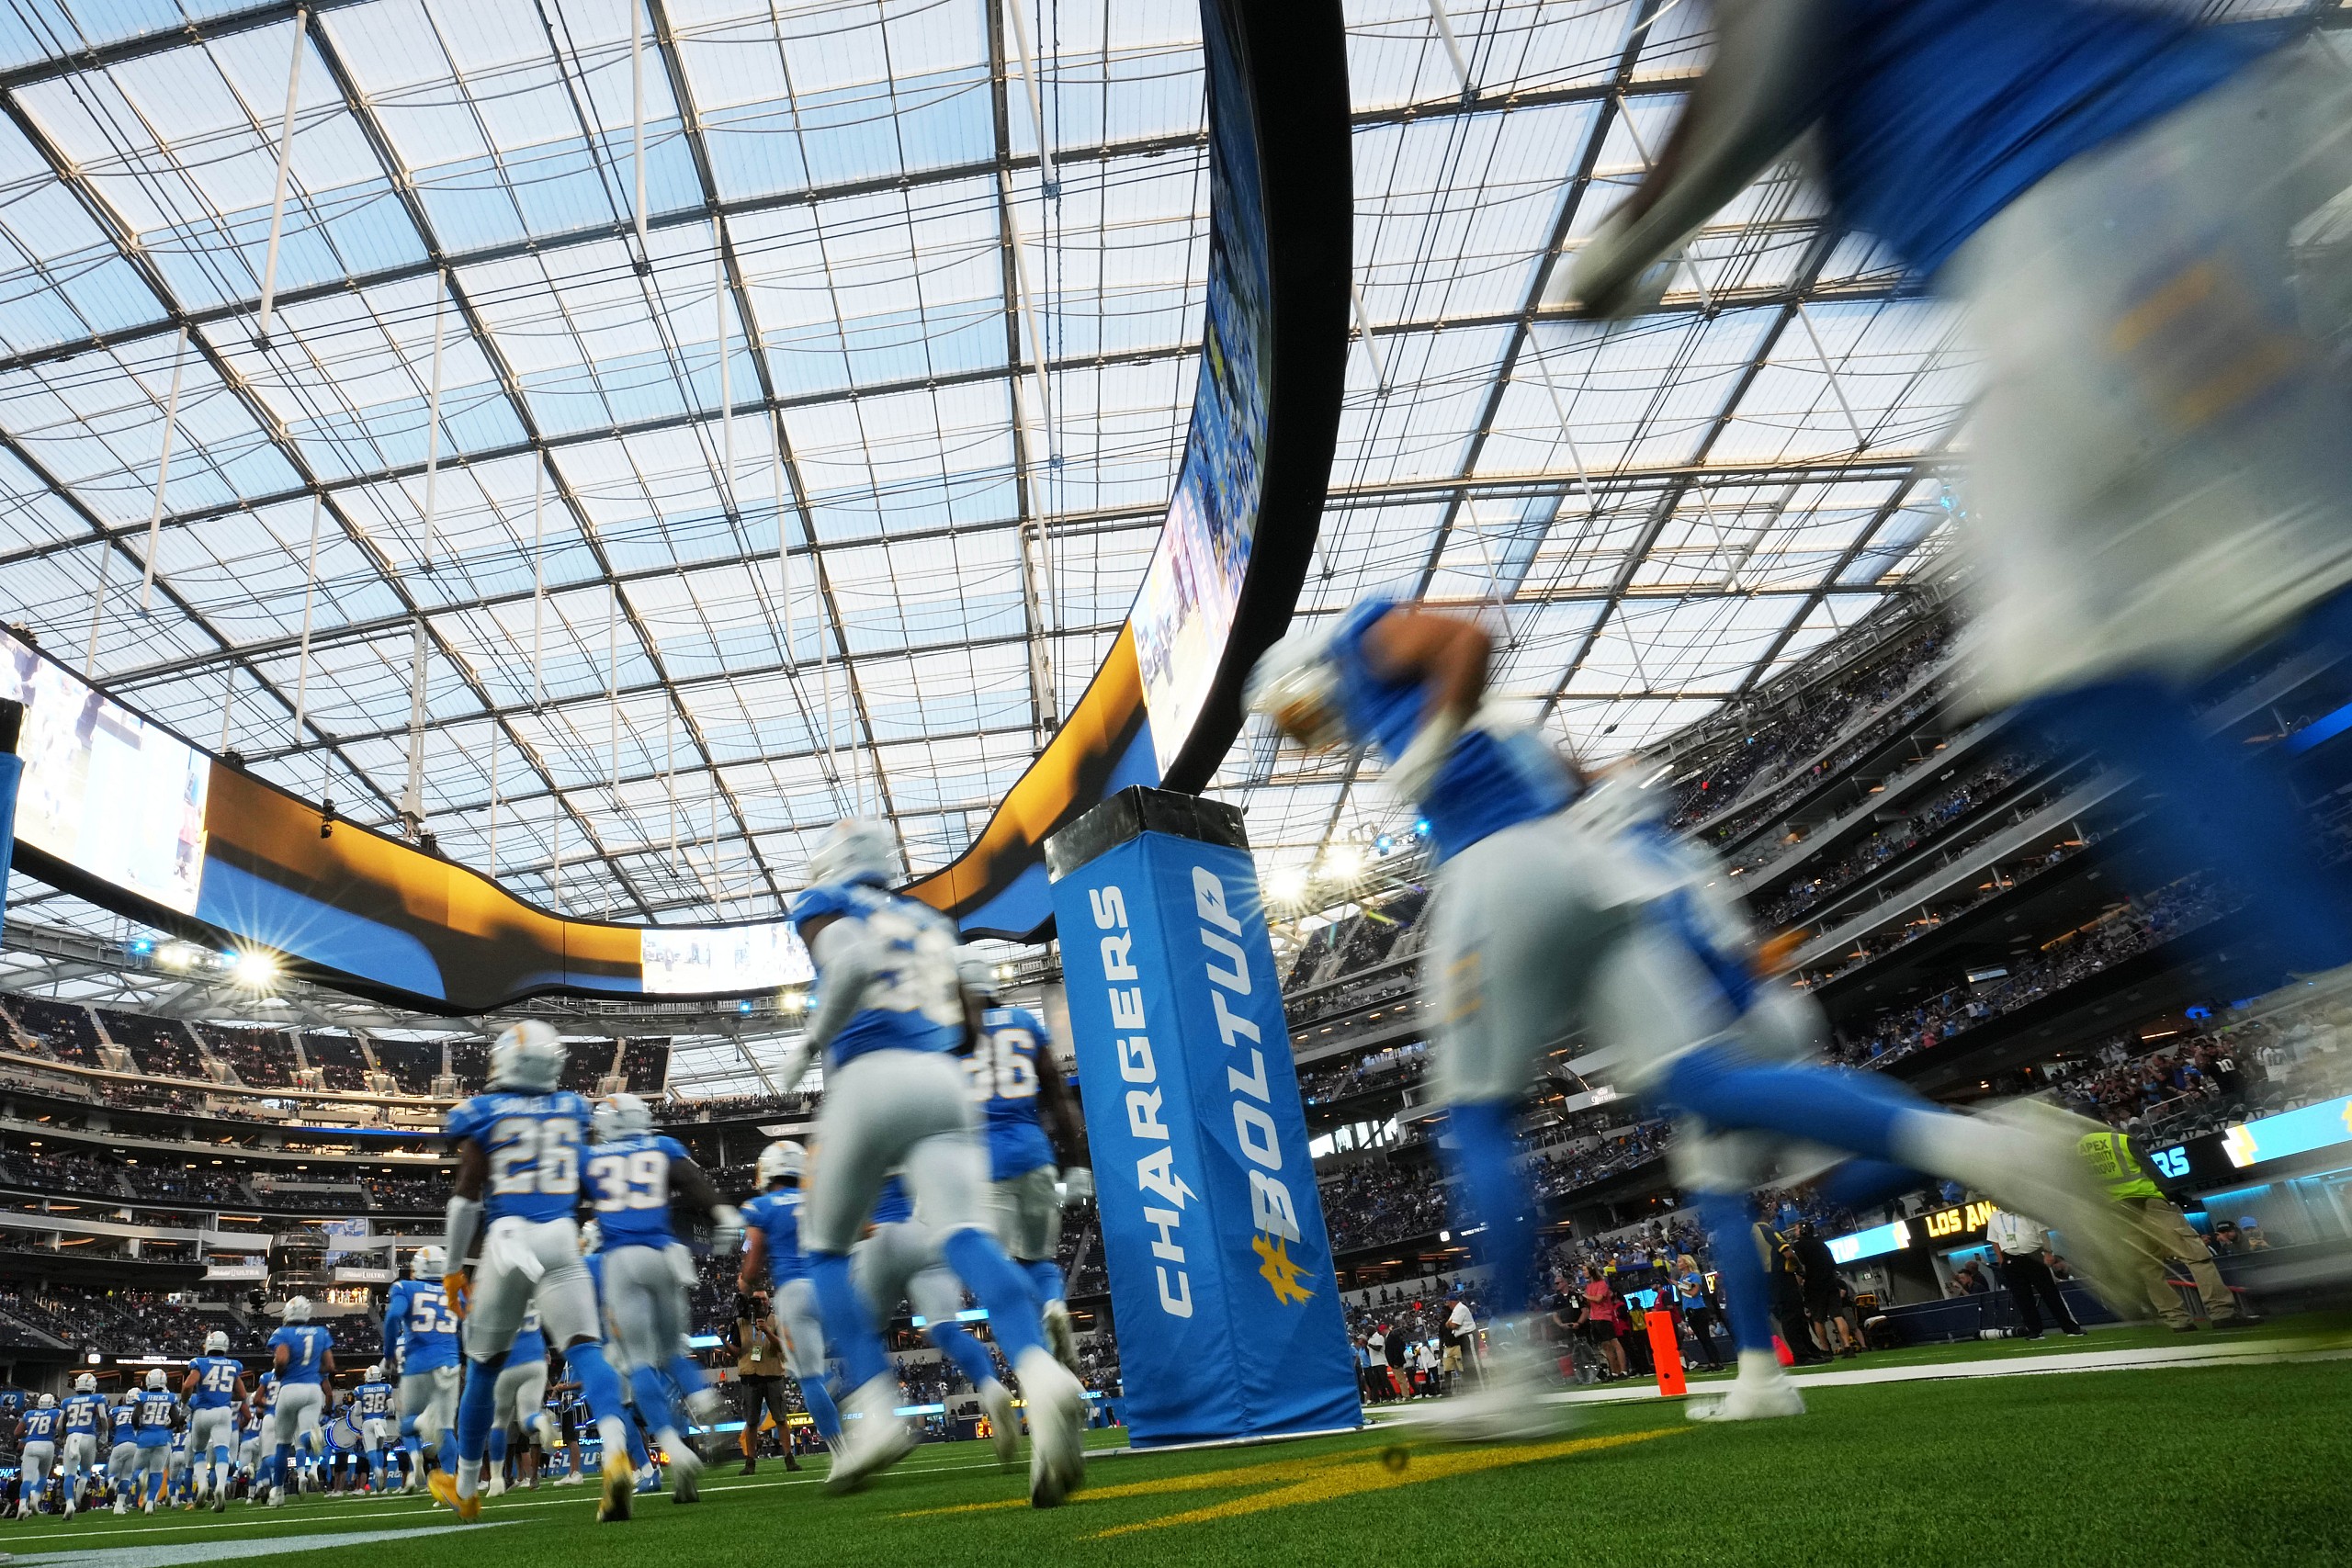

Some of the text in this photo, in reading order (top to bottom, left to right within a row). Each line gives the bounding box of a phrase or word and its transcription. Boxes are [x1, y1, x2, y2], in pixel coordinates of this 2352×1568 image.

[2216, 1058, 2236, 1073] 10
[1192, 865, 1316, 1306] #BOLTUP
[1089, 885, 1200, 1318] CHARGERS
[489, 1117, 581, 1194] 26
[2079, 1139, 2109, 1154] APEX
[586, 1150, 670, 1213] 39
[1925, 1200, 1997, 1238] LOS AN
[412, 1292, 458, 1334] 53
[301, 1335, 314, 1366] 1
[202, 1365, 237, 1393] 45
[66, 1403, 96, 1427] 35
[362, 1393, 387, 1414] 38
[28, 1416, 51, 1436] 78
